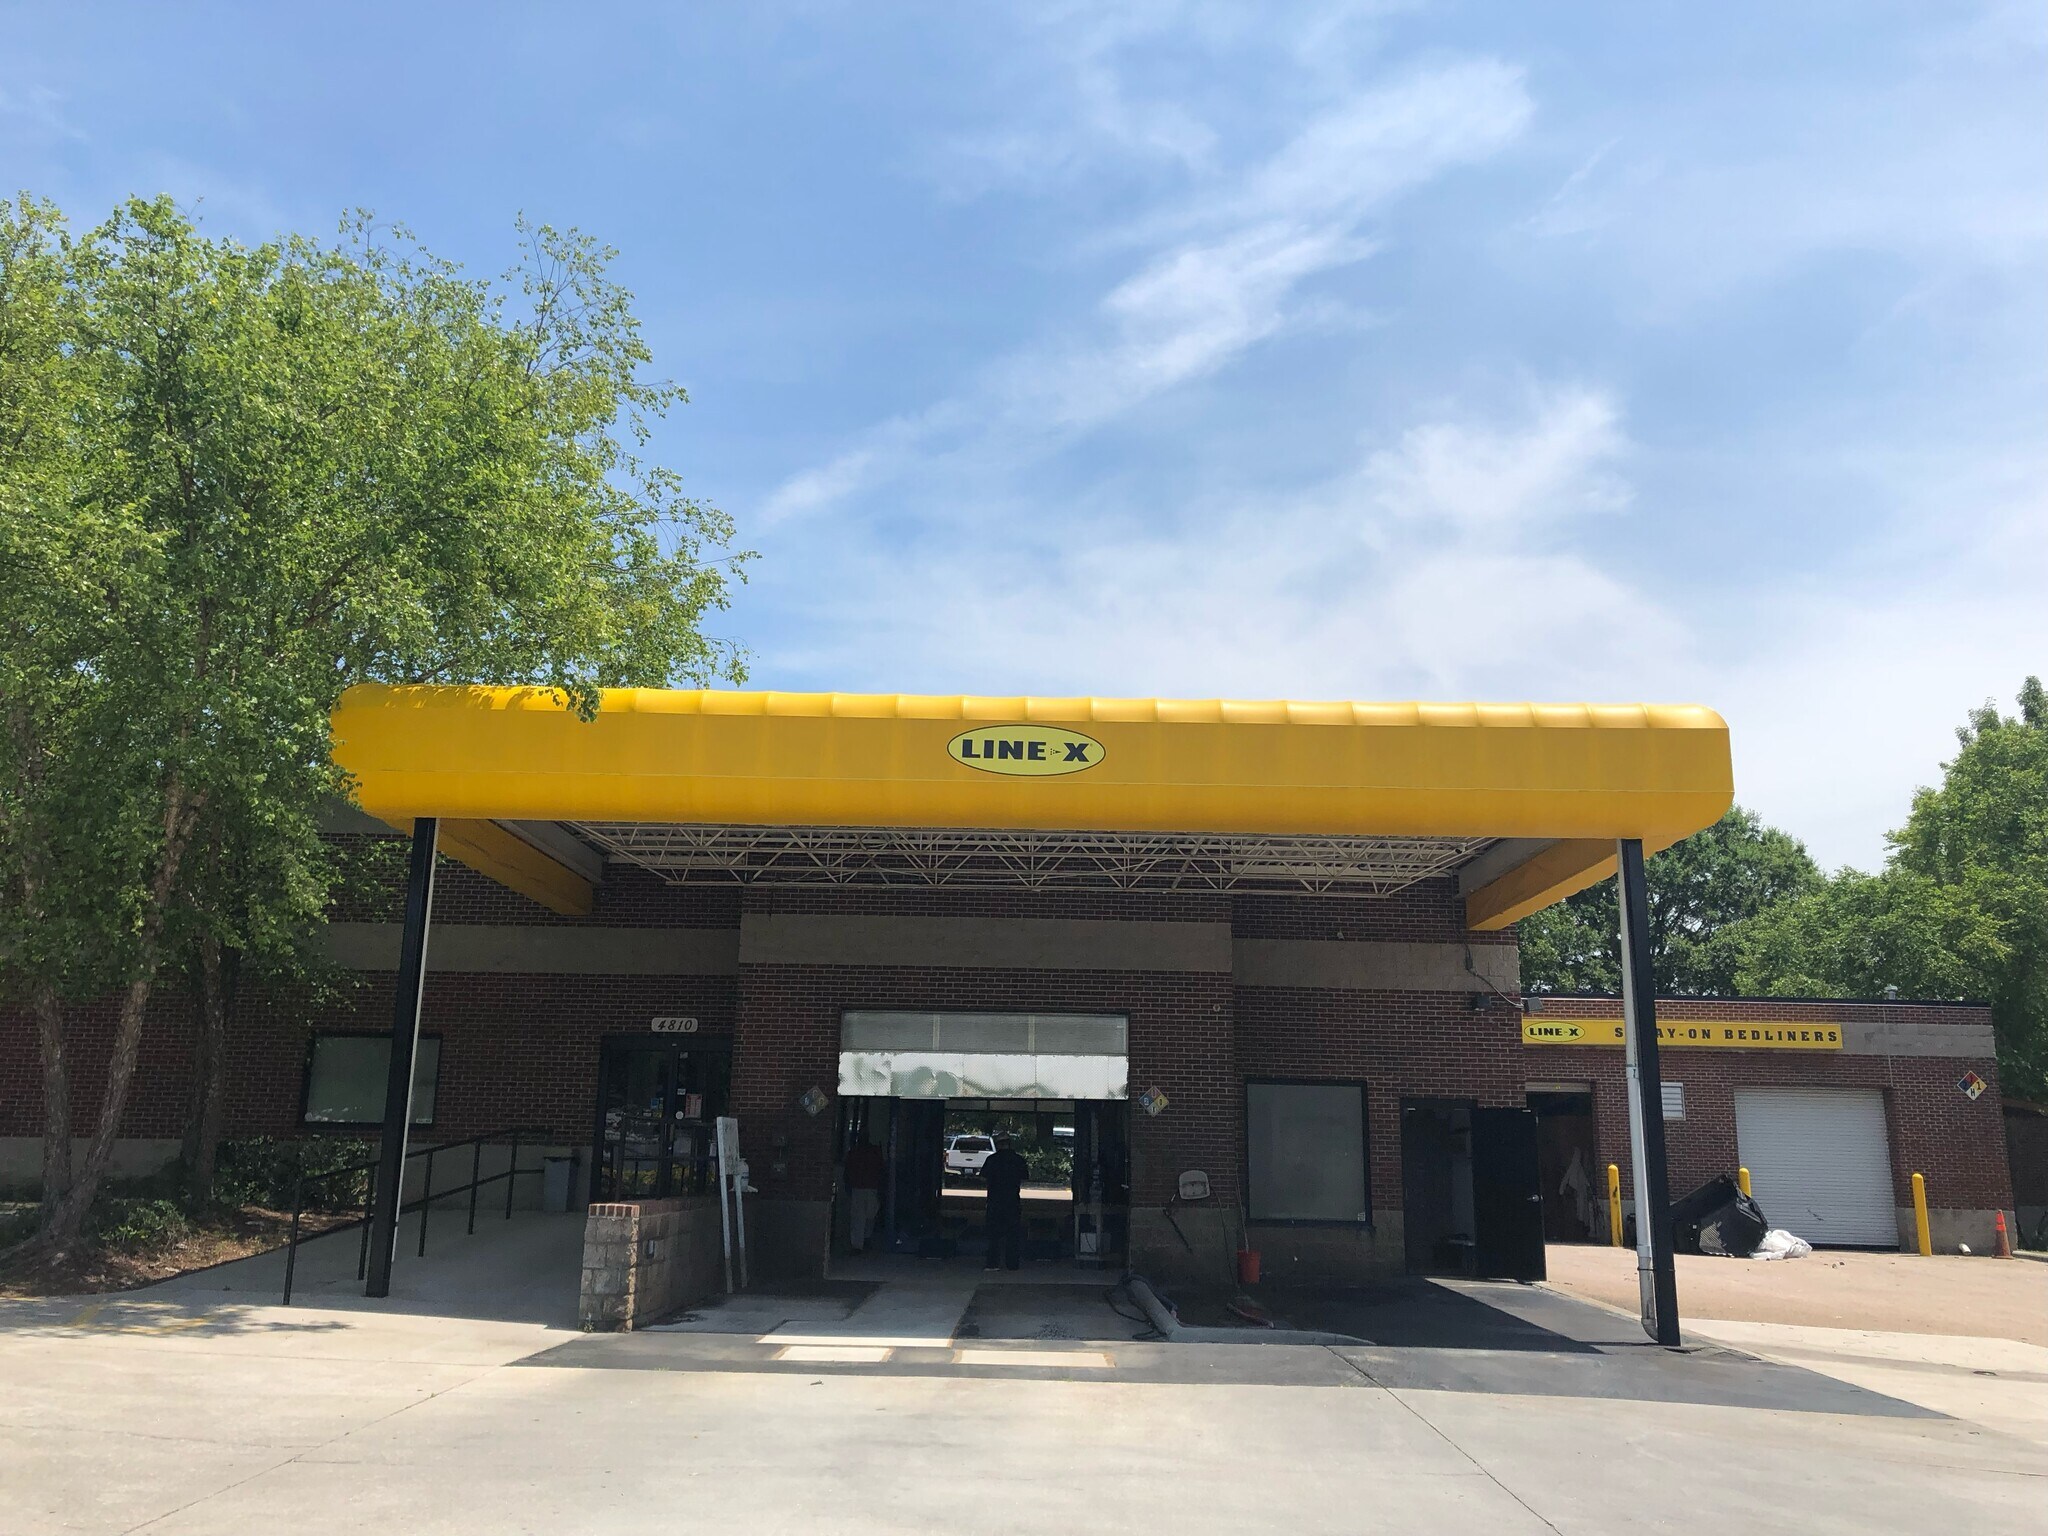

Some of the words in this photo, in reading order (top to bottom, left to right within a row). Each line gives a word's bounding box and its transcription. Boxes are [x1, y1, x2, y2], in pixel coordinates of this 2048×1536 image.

[657, 1019, 693, 1031] 4810
[1614, 1027, 1711, 1040] SAY-ON
[1724, 1029, 1838, 1041] BEDLINERS
